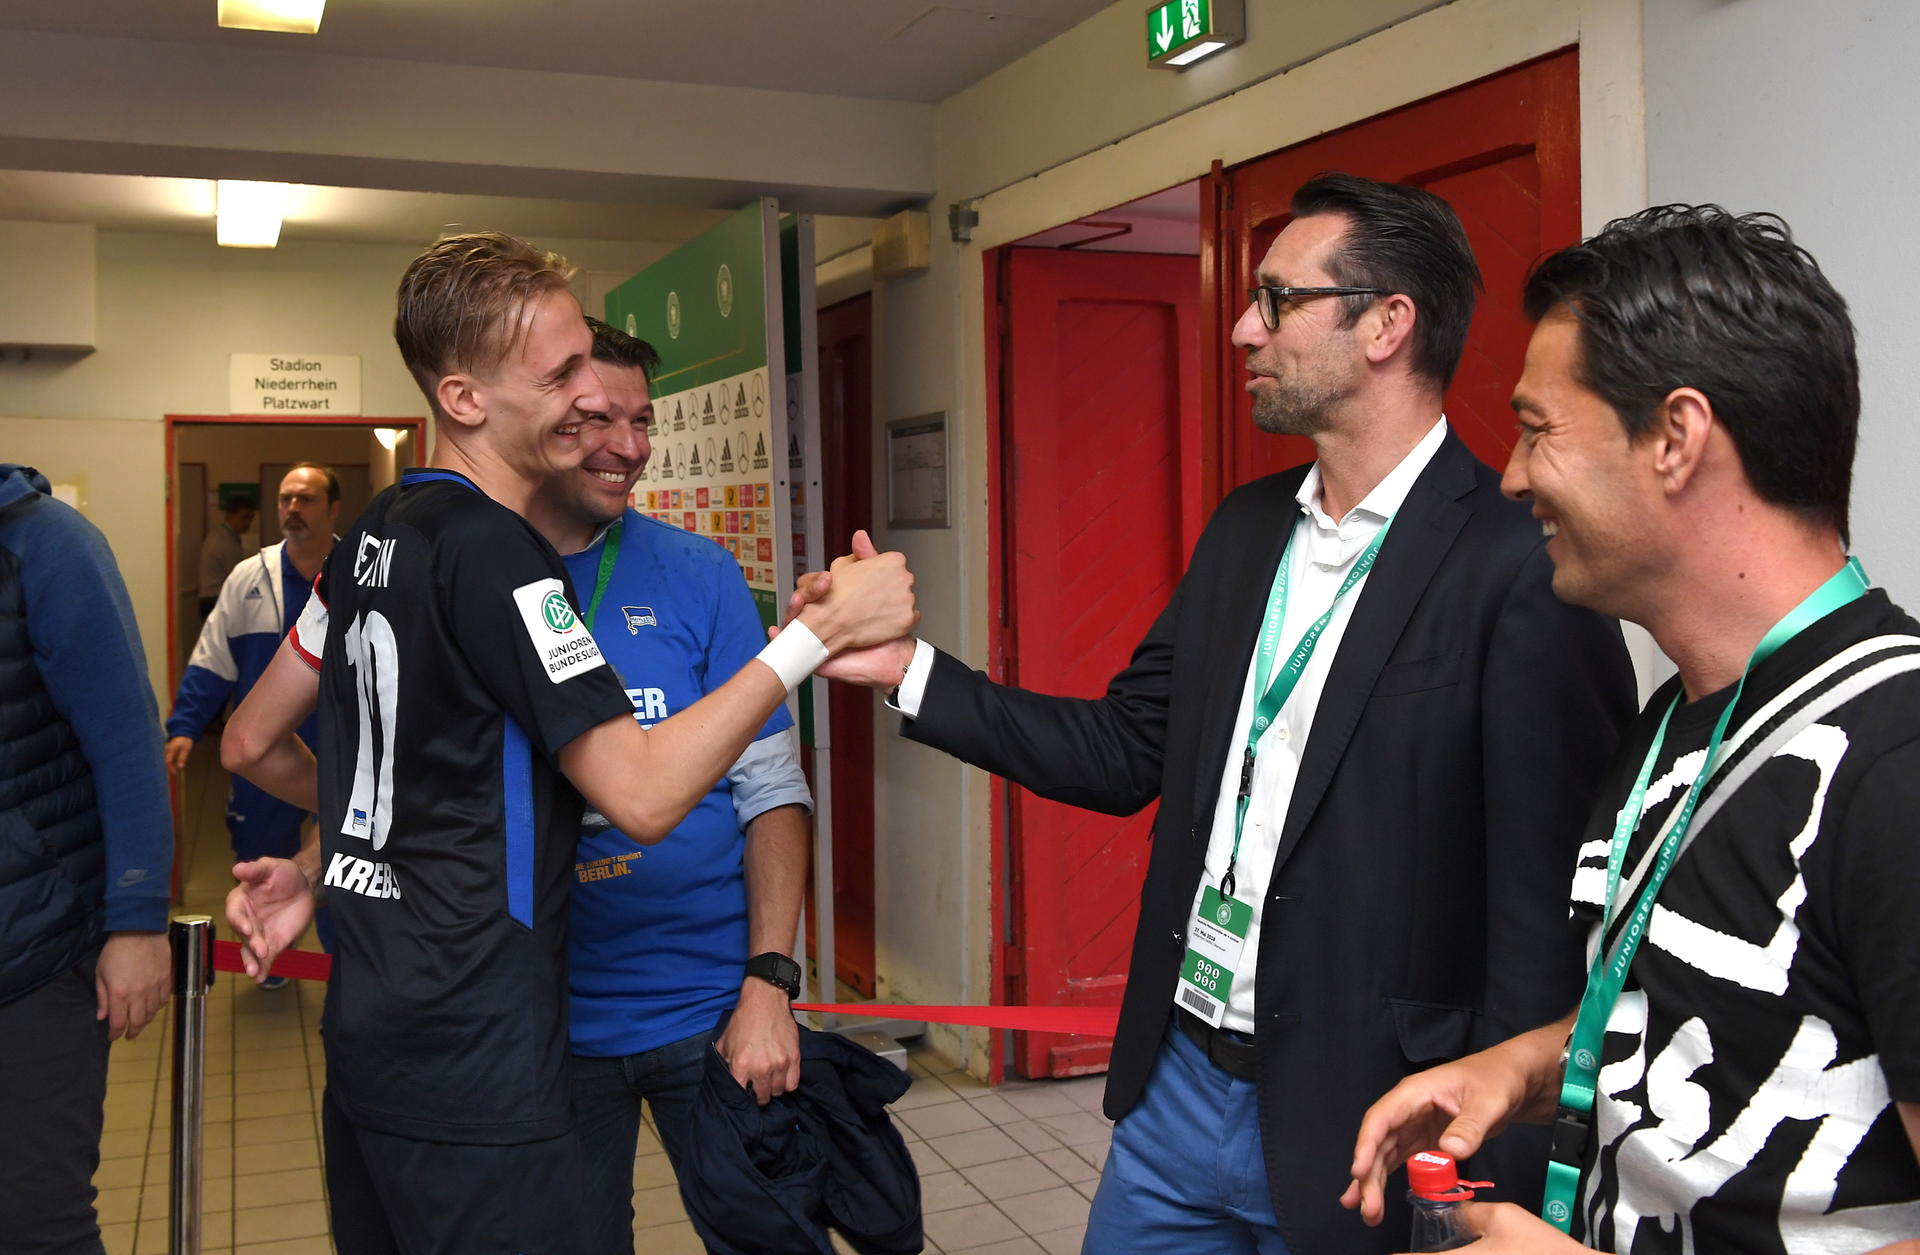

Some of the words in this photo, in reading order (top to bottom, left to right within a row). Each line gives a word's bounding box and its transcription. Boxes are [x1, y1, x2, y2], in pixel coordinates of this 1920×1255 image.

[270, 358, 322, 371] Stadion
[255, 378, 337, 391] Niederrhein
[263, 396, 330, 409] Platzwart
[340, 609, 399, 851] 10
[578, 861, 632, 883] BERLIN.
[1614, 774, 1705, 978] JUNIOREN-BUNDESLIGA
